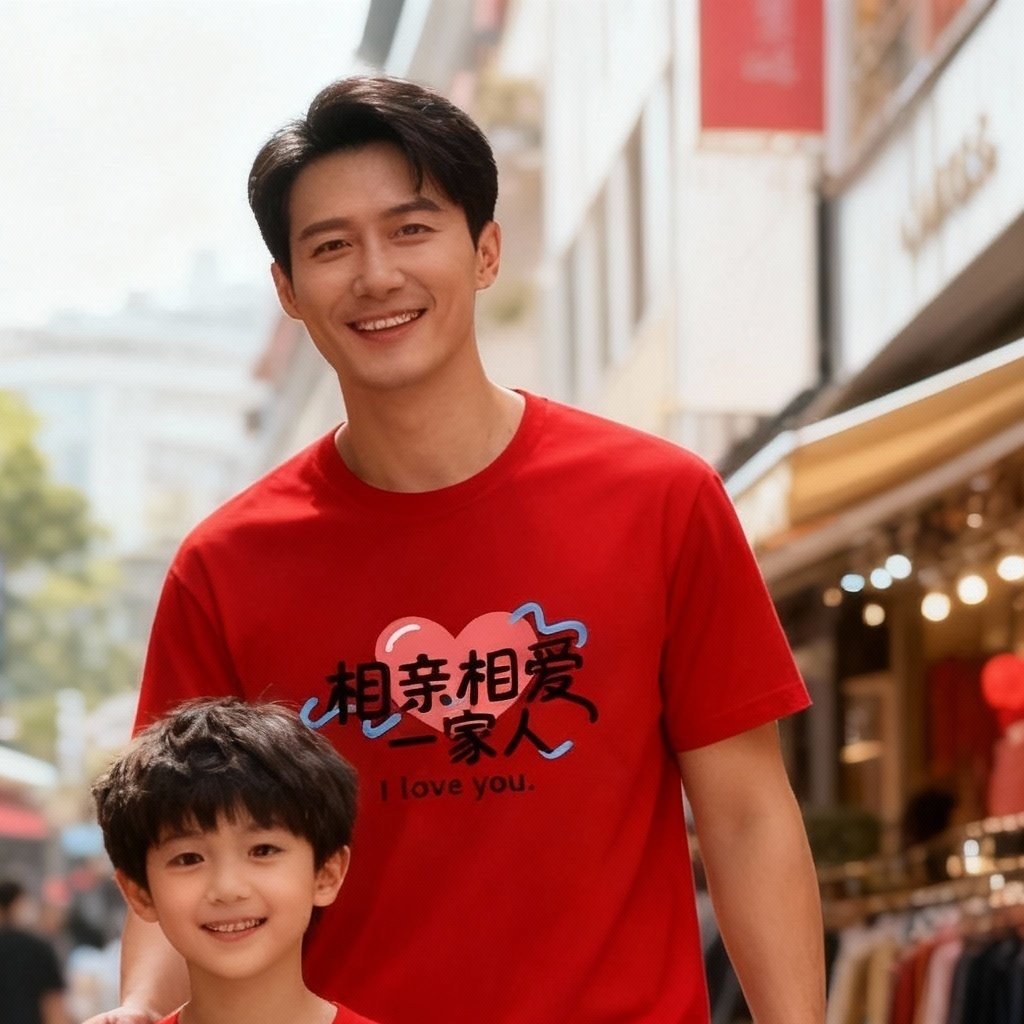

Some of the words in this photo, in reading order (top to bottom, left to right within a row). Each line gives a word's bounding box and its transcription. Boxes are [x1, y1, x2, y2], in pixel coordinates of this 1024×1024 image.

[326, 635, 598, 725] 相亲相爱
[388, 707, 553, 766] 一家人
[379, 779, 388, 802] I
[400, 774, 463, 801] love
[472, 773, 536, 801] you.
